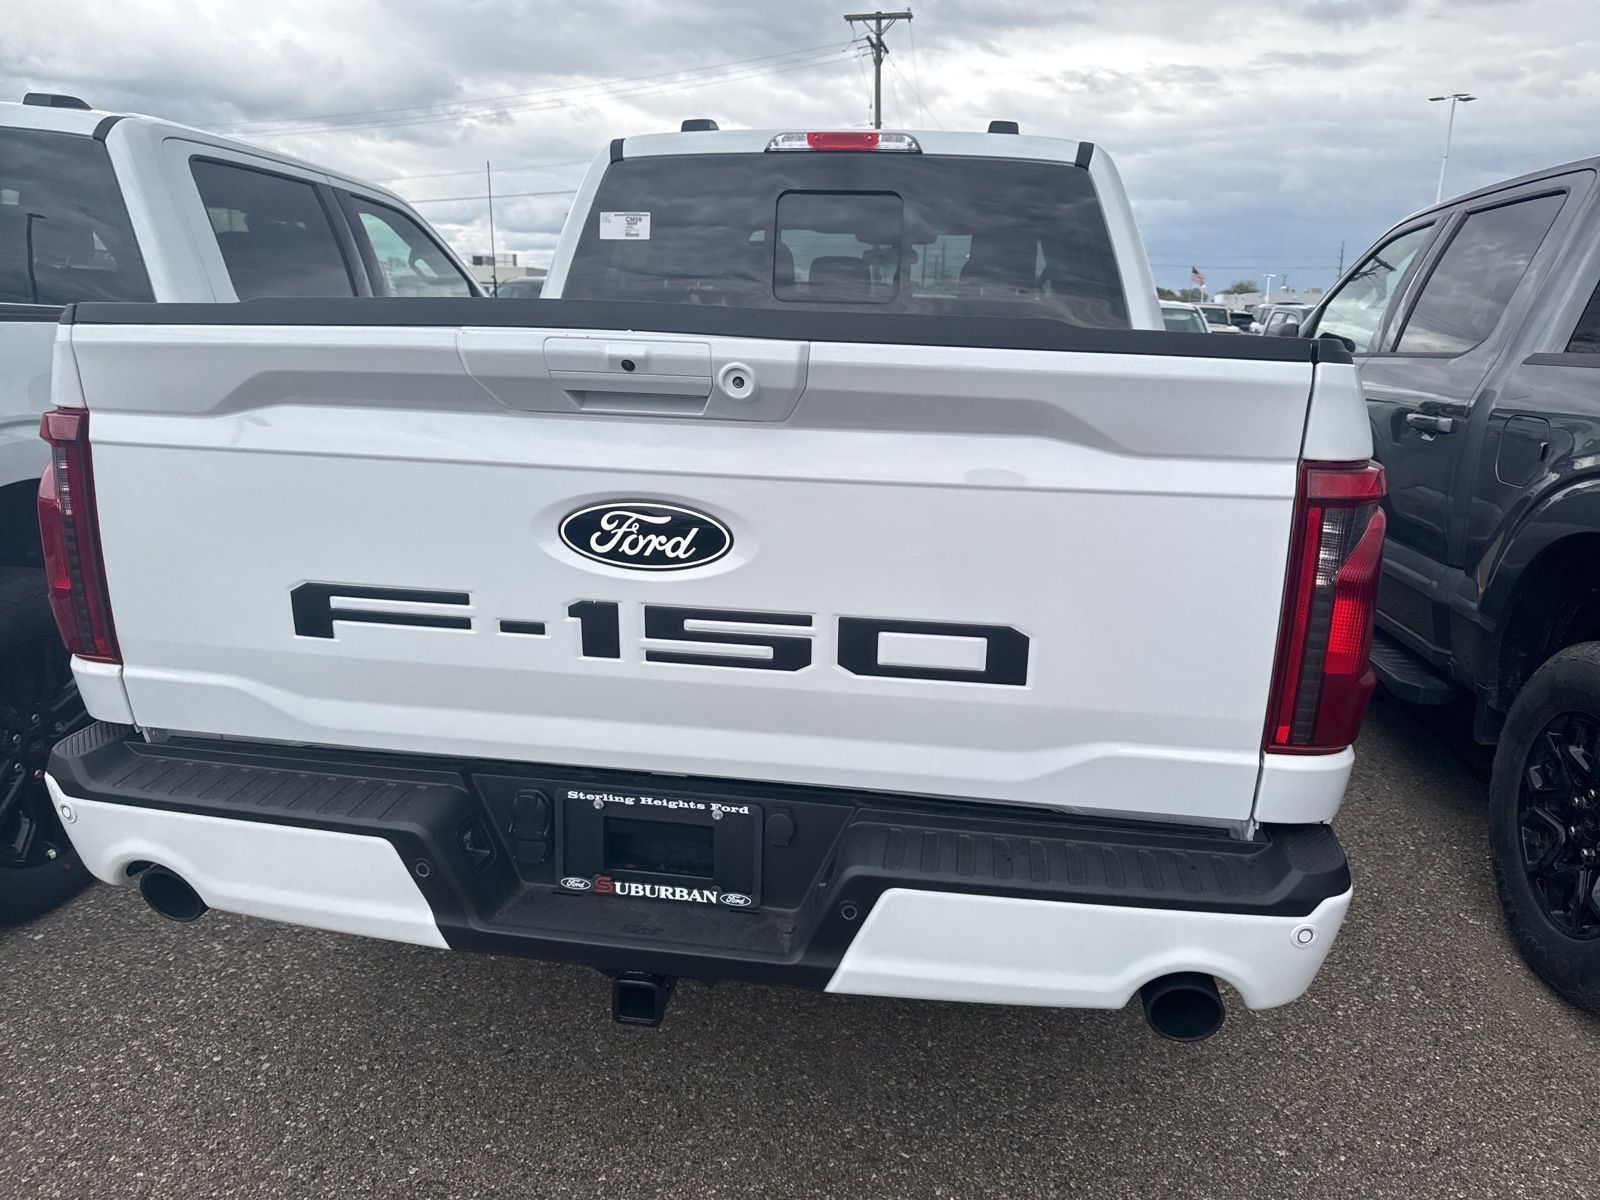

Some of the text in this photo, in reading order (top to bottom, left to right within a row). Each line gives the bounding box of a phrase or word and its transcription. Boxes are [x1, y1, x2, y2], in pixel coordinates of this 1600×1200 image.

[590, 511, 699, 558] Ford
[291, 582, 1030, 687] F-150
[567, 790, 750, 814] Sterling Heights Ford
[595, 875, 718, 904] SUBURBAN
